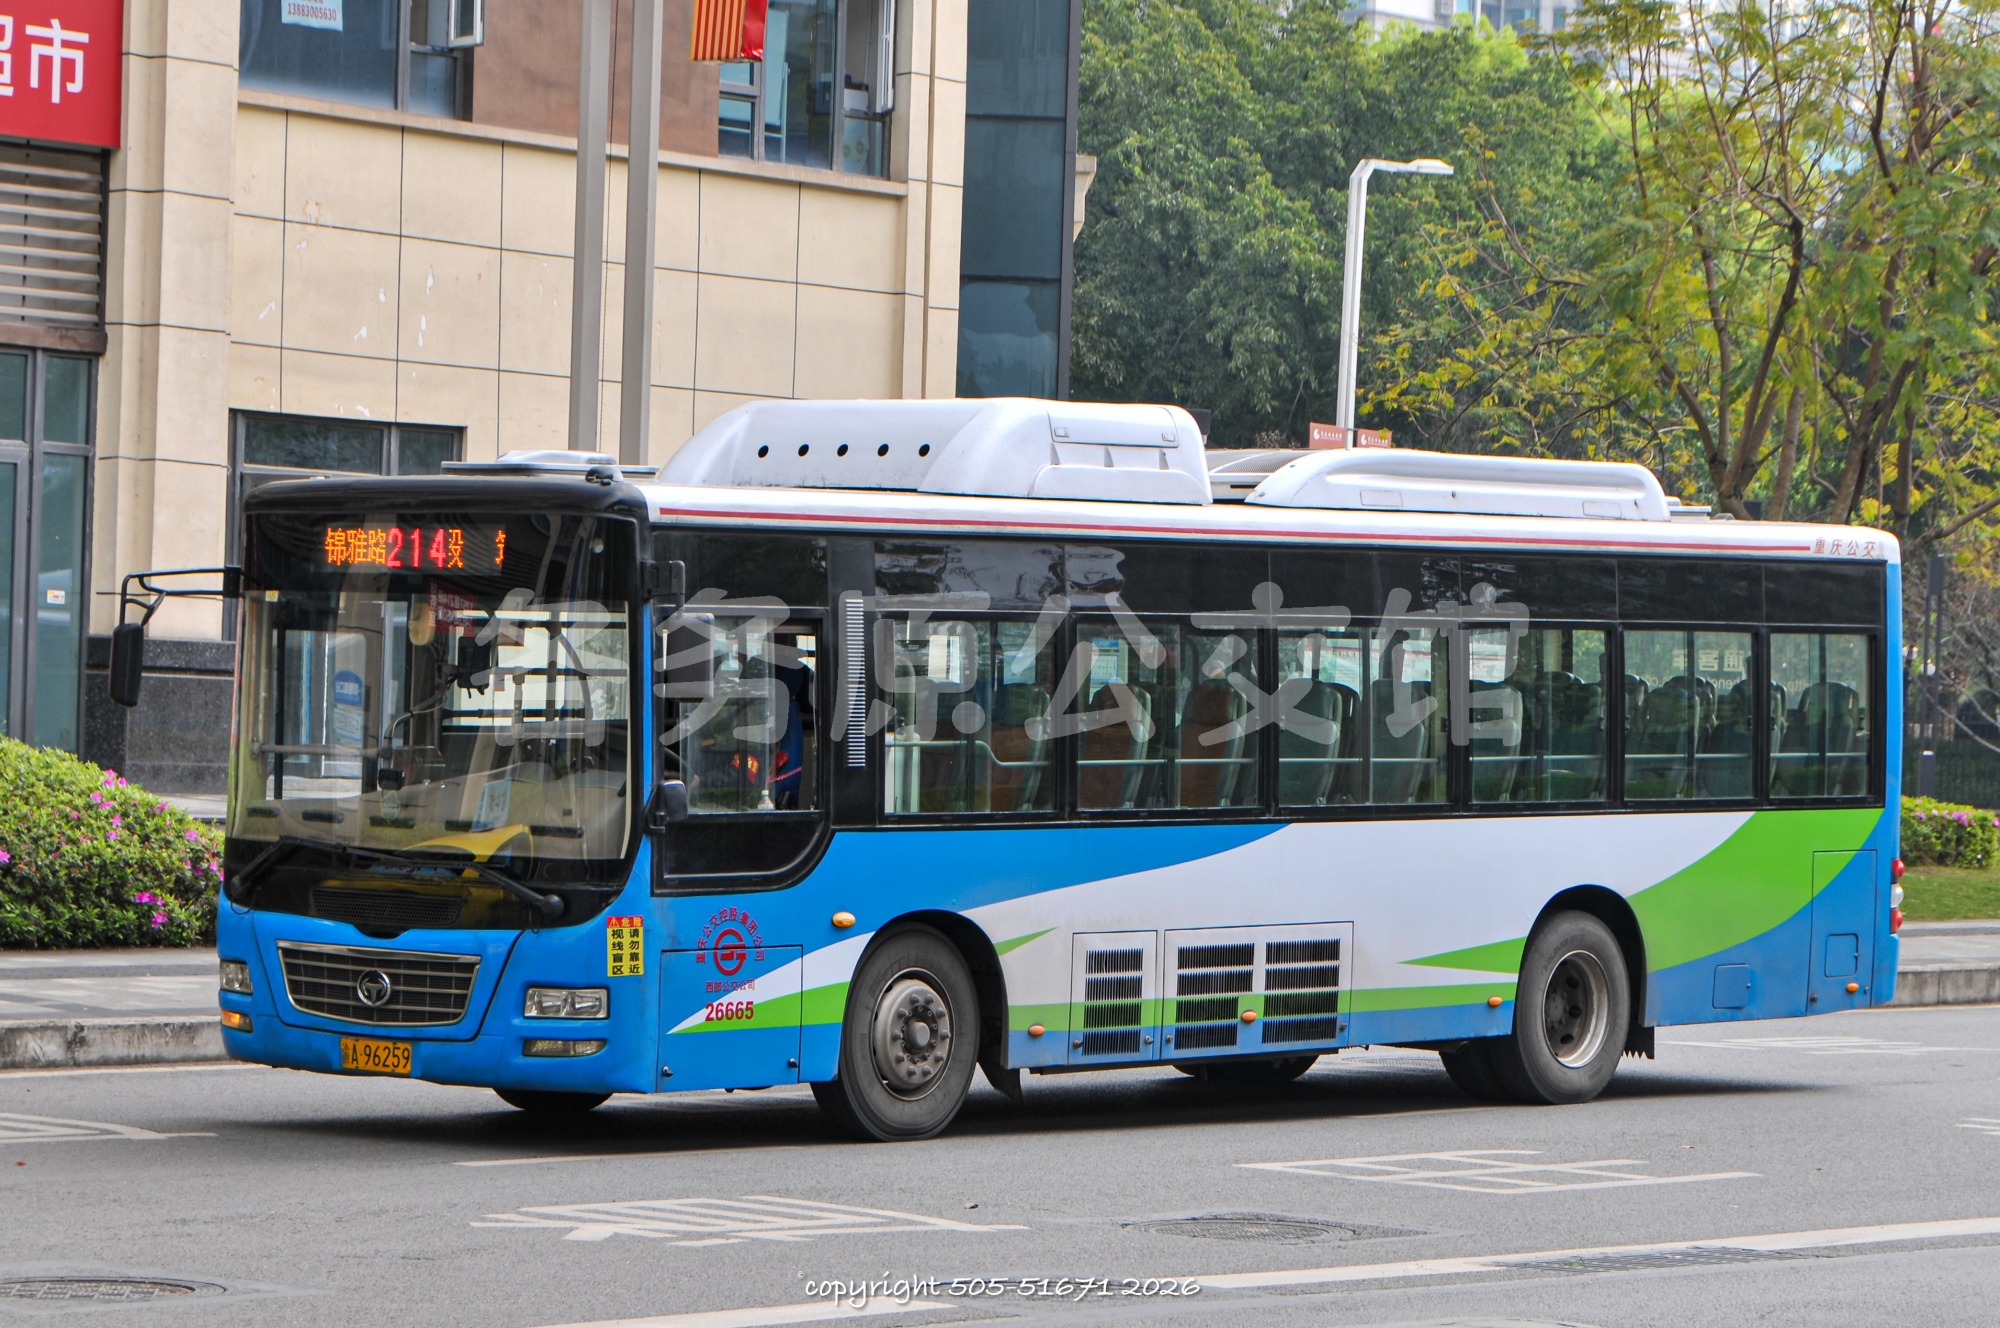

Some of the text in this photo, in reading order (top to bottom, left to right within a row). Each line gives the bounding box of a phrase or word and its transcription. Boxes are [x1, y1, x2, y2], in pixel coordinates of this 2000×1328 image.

[288, 3, 337, 21] 13883005630
[1814, 536, 1876, 558] 重庆公交
[621, 916, 642, 928] 危险
[611, 928, 625, 976] 视线盲区
[628, 927, 641, 974] 请勿靠近
[705, 979, 756, 993] 西部公交公司
[704, 1001, 755, 1023] 26665
